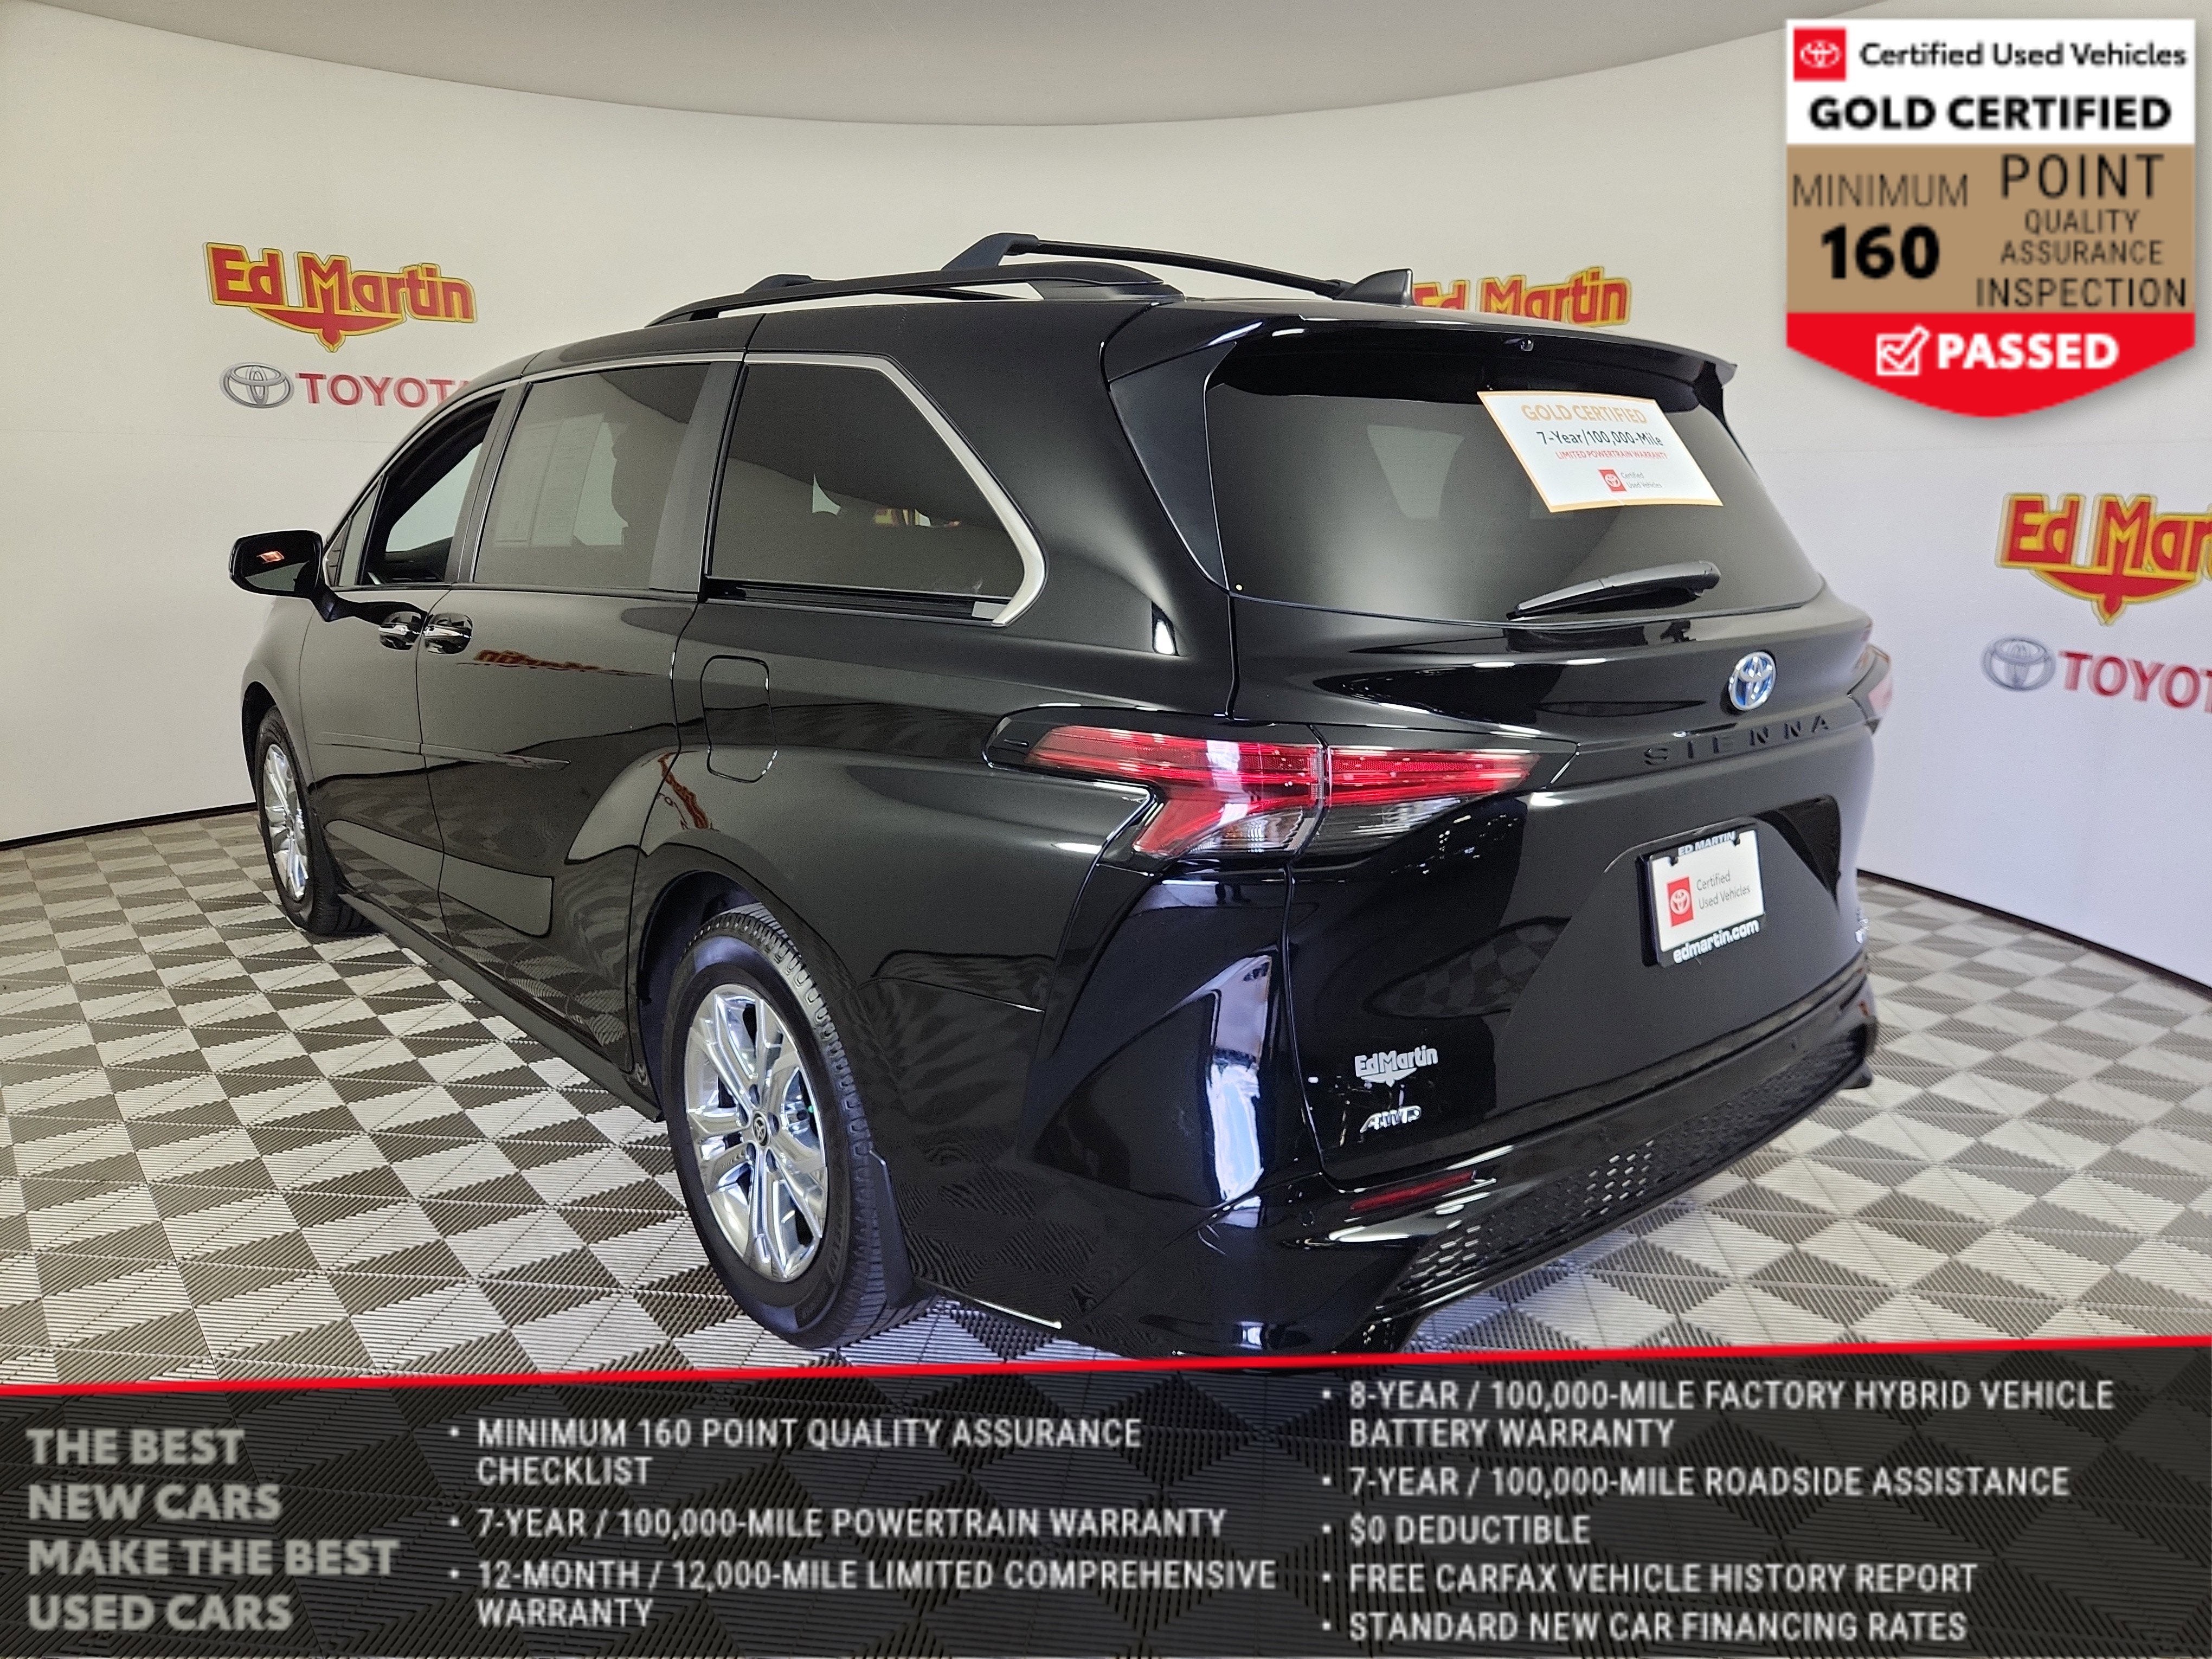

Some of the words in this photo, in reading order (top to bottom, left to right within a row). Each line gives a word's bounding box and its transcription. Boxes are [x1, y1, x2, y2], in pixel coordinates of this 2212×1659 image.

[207, 243, 285, 306] Ed
[297, 252, 476, 321] Martin
[295, 372, 469, 408] TOYOT
[1521, 404, 1572, 422] GOLD
[1573, 406, 1647, 424] CERTIFIED
[1536, 429, 1663, 446] 7-Year/100,000-Mile
[1555, 449, 1586, 459] LIMITED
[1587, 450, 1633, 459] POWERTRAIN
[1633, 451, 1668, 459] WARRANTY
[2001, 494, 2083, 565] Ed
[2090, 494, 2212, 575] Mar
[1644, 714, 1830, 766] SIENNA
[1678, 841, 1694, 856] ED
[1695, 830, 1736, 852] MARTIN
[1696, 870, 1731, 891] Certified
[1698, 891, 1719, 910] Used
[1719, 883, 1751, 905] Vehicles
[1673, 919, 1759, 964] edmartin.com
[1359, 1105, 1422, 1133] AWD
